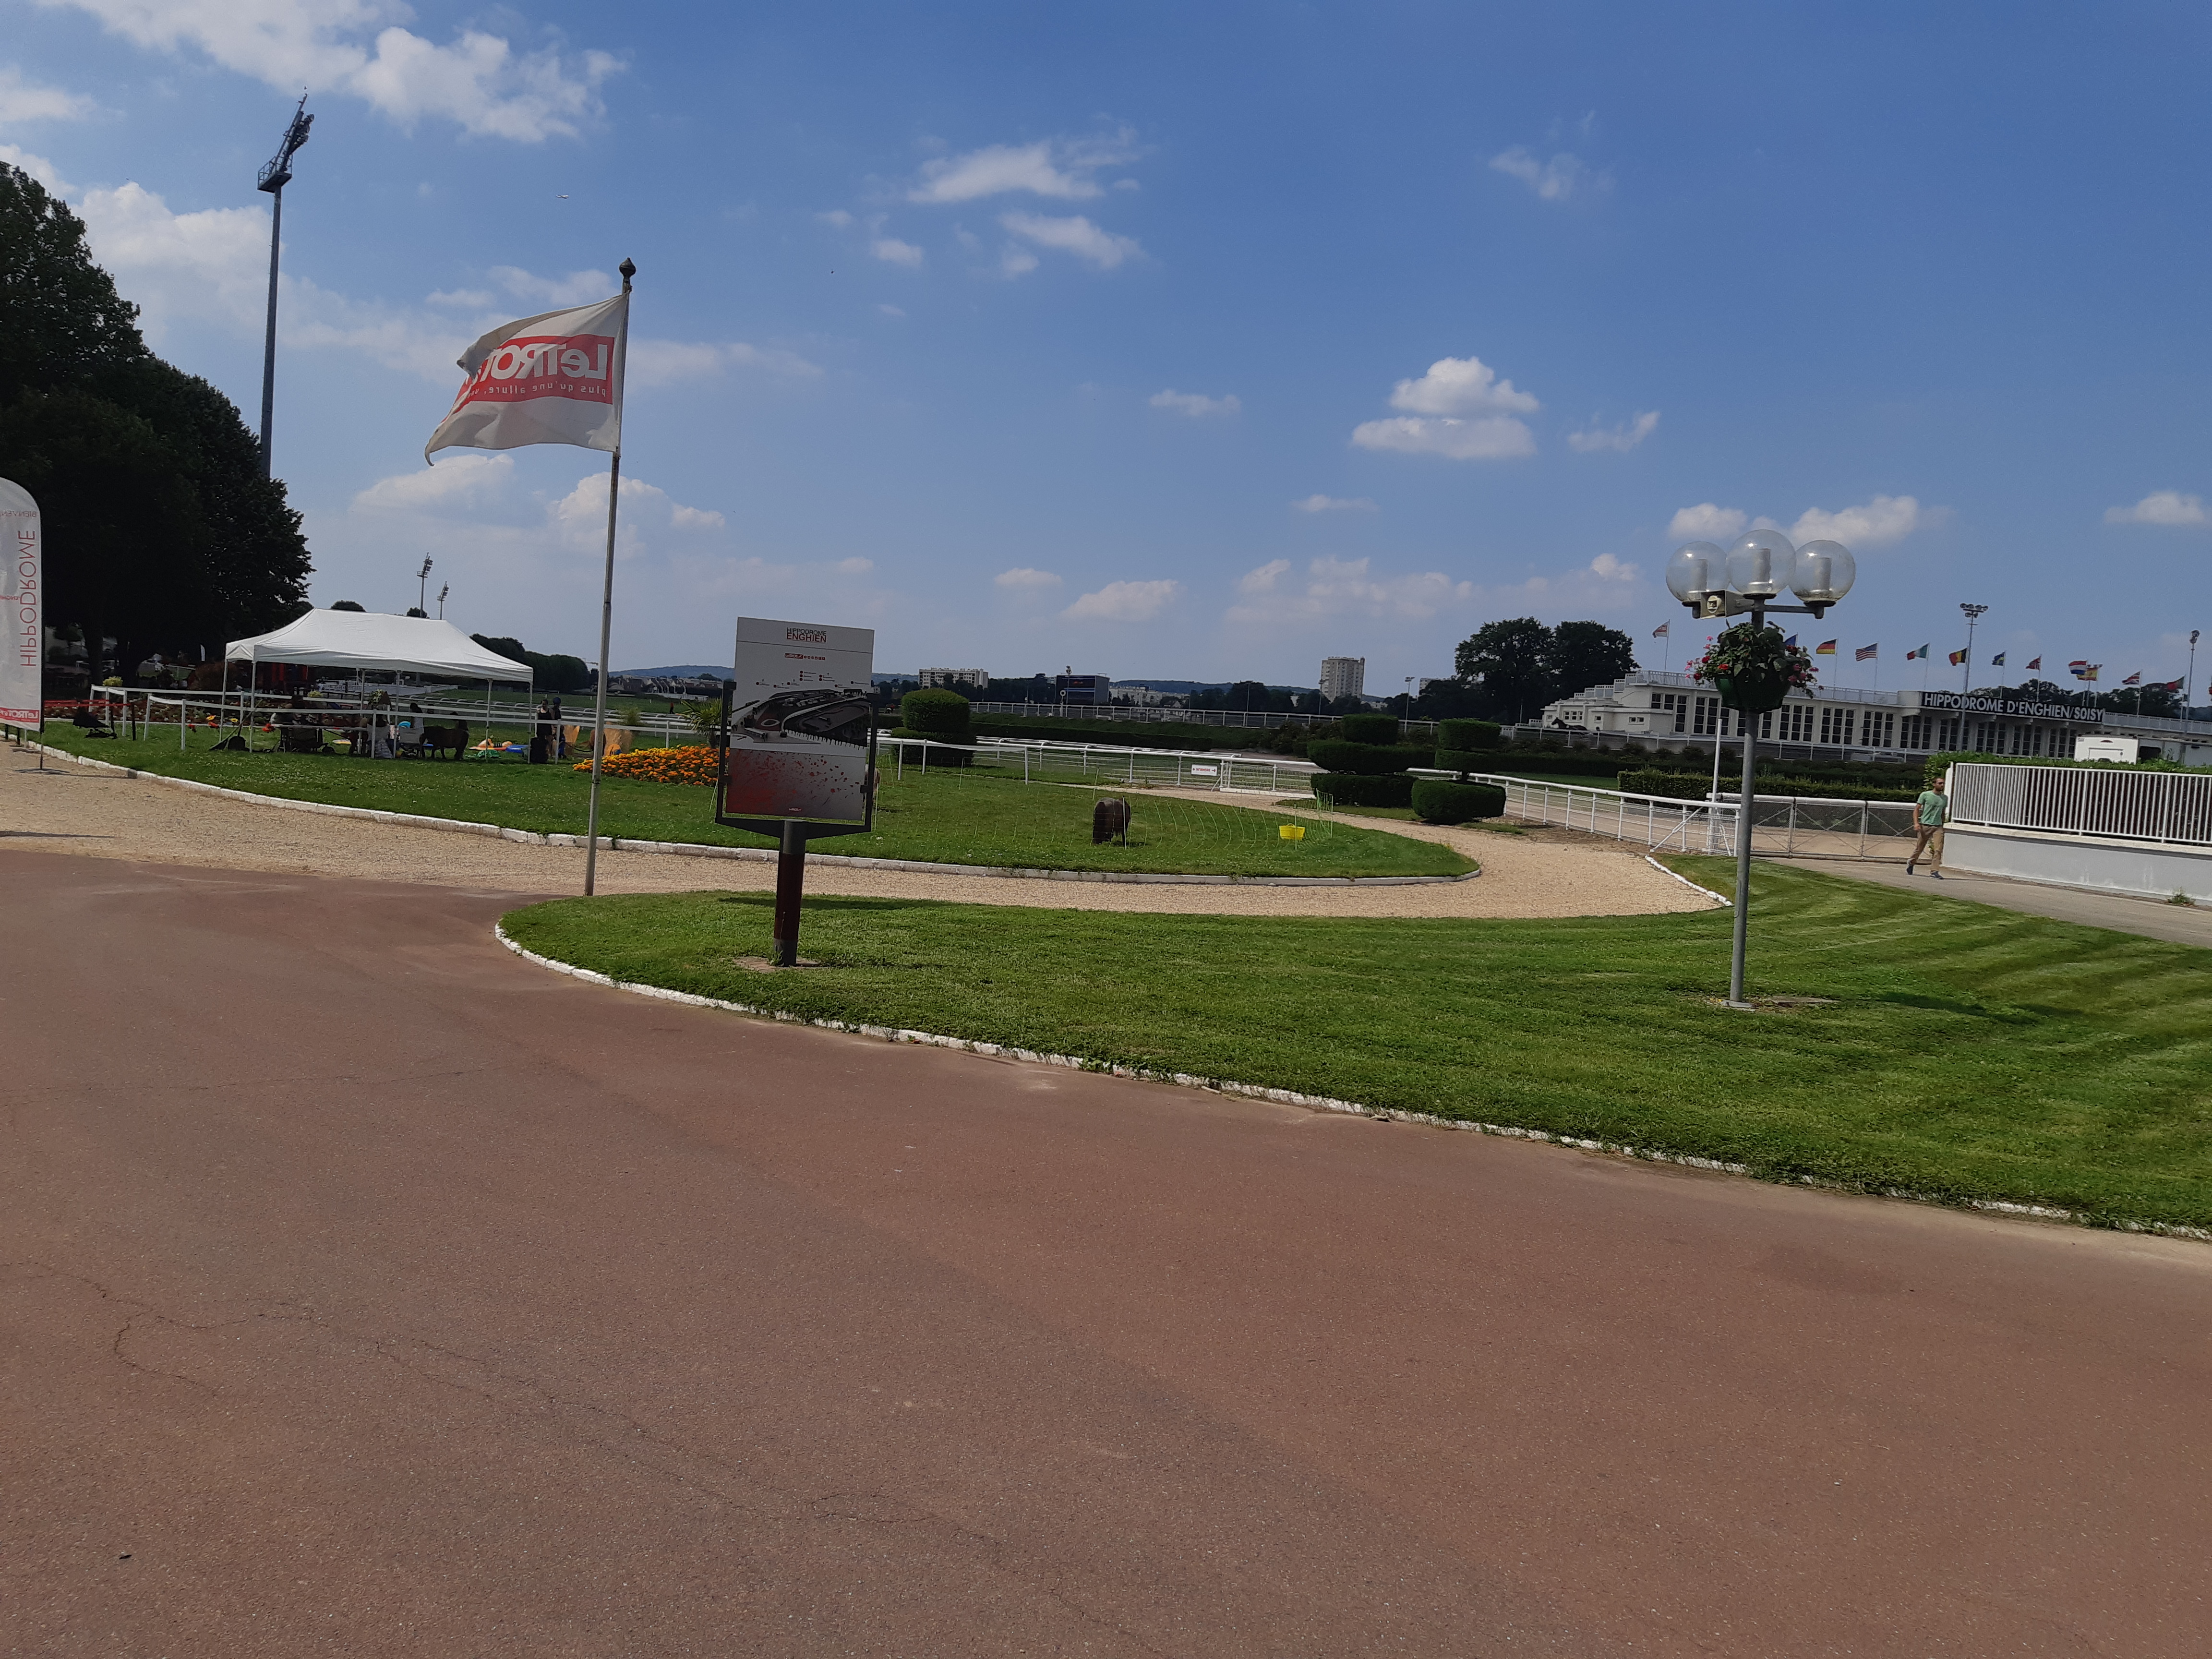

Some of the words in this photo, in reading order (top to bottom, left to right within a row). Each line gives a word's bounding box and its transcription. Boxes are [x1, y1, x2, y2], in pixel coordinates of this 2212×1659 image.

[787, 627, 827, 636] HIPPODROME
[786, 632, 827, 643] ENGHIEN
[1924, 693, 2004, 712] HIPPODROME
[2007, 700, 2104, 721] D'ENGHIEN/SOISY
